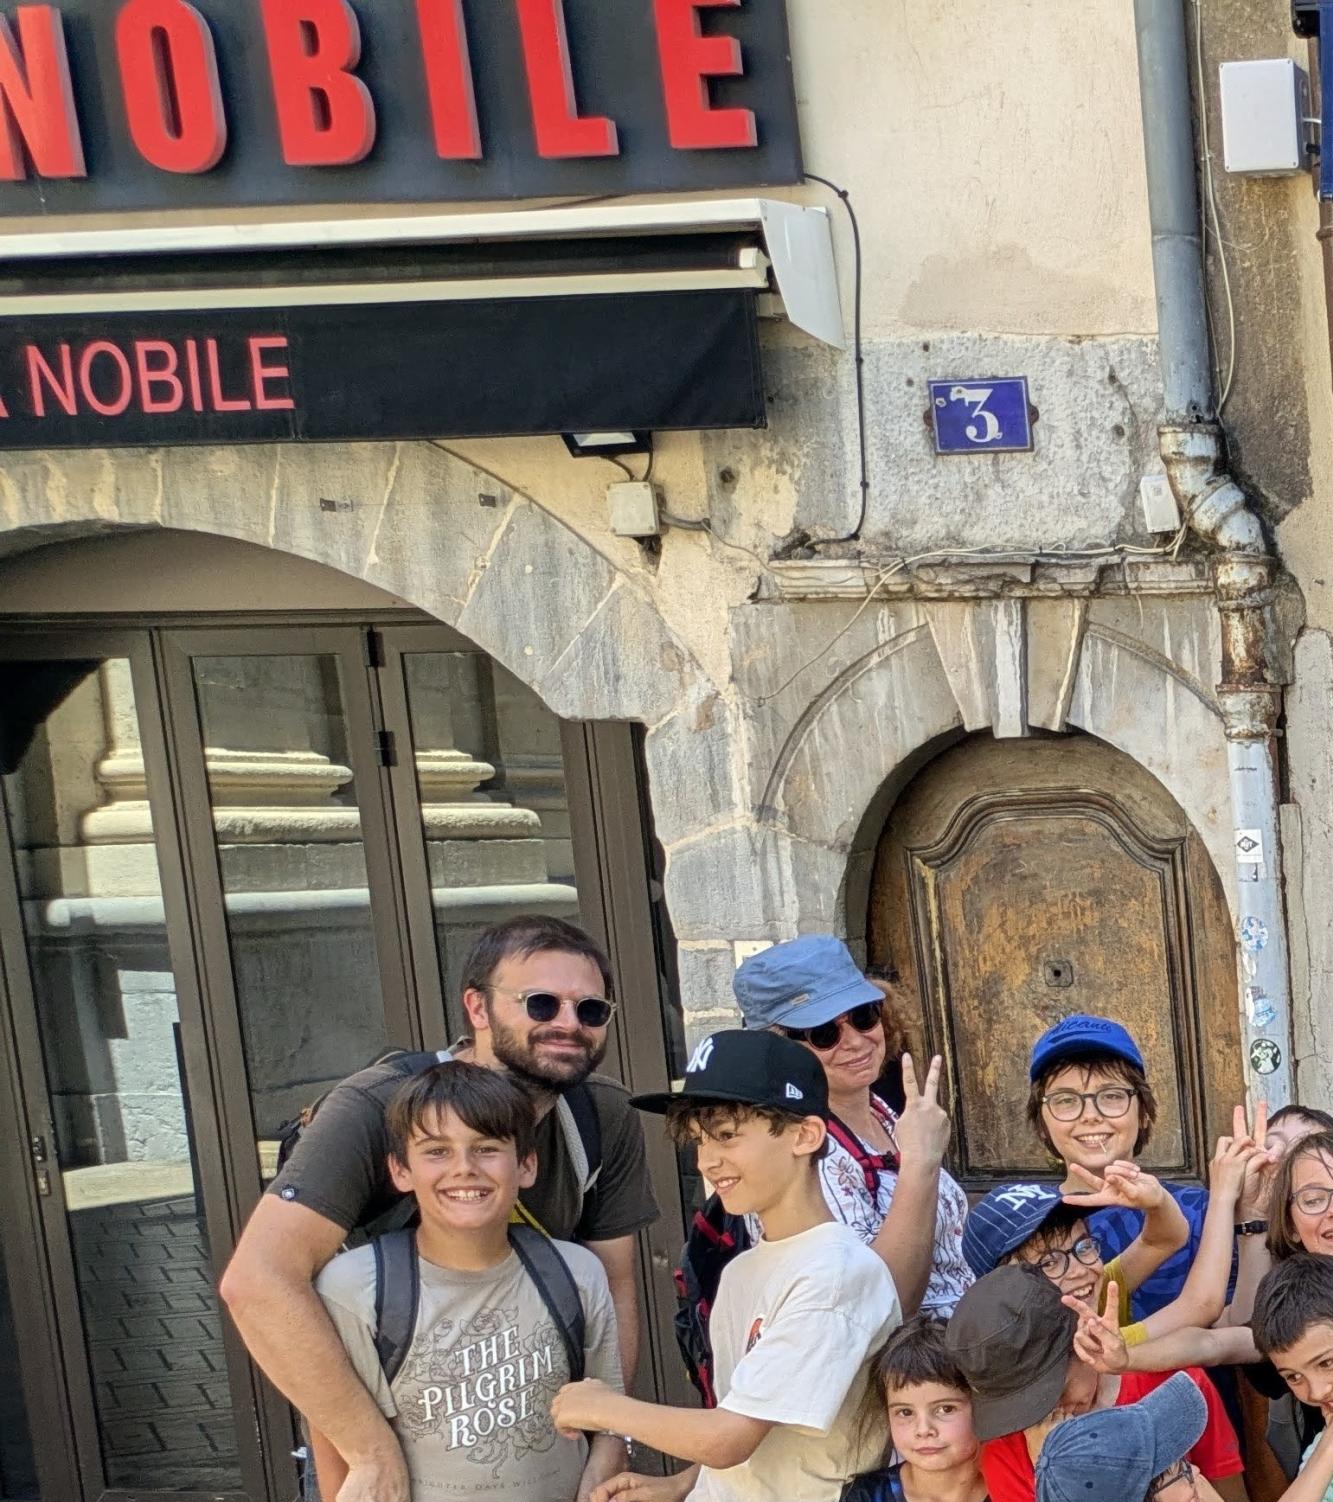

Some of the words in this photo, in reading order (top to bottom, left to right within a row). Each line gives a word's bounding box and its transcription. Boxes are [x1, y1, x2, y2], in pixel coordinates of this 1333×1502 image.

[0, 0, 757, 181] NOBILE
[26, 336, 296, 417] NOBILE
[950, 386, 1001, 443] 3
[417, 1345, 553, 1424] PILGRIM
[455, 1326, 521, 1379] THE
[447, 1385, 537, 1451] ROSE
